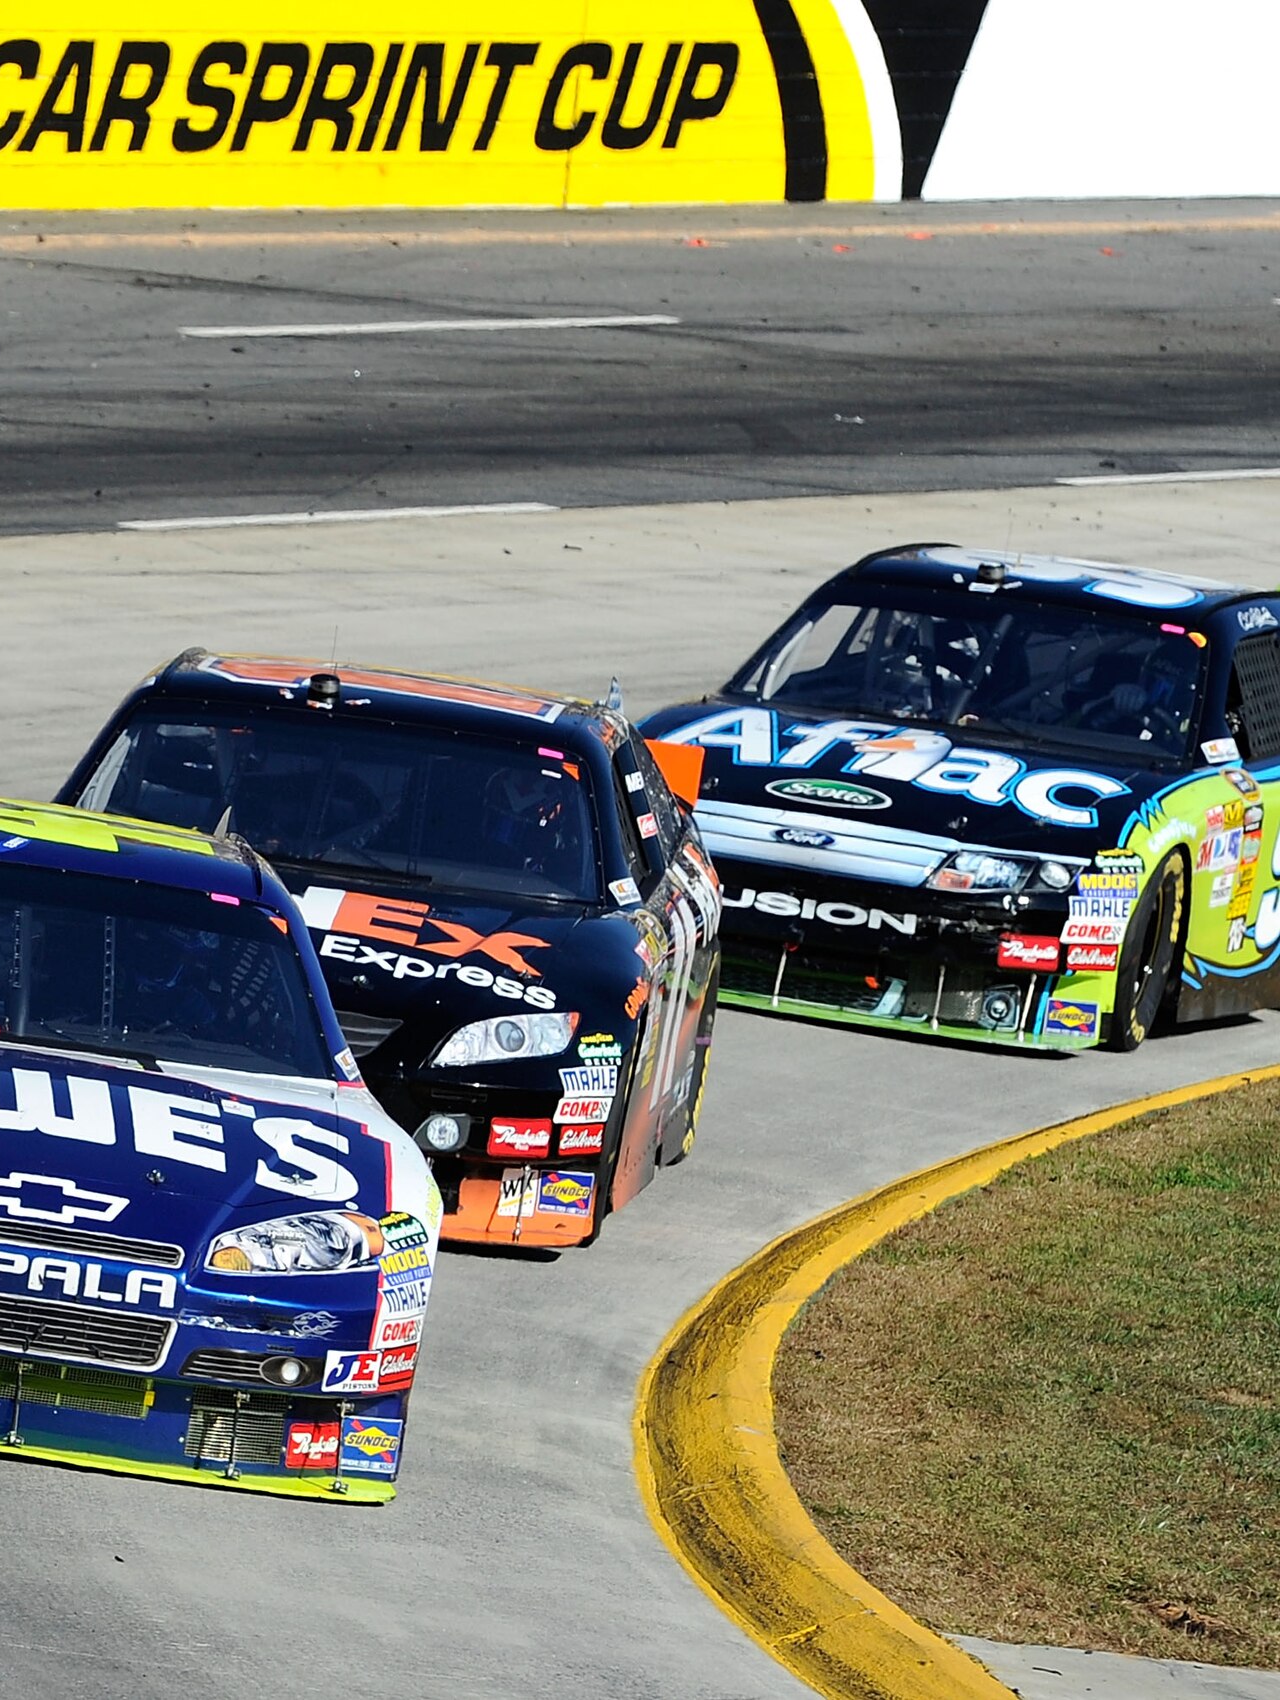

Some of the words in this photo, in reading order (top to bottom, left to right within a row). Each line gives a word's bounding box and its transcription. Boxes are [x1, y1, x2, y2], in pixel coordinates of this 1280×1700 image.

[172, 40, 540, 155] SPRINT
[539, 40, 741, 152] CUP
[658, 705, 1133, 828] Aflac
[1078, 873, 1137, 890] MOOG
[718, 883, 918, 937] USION
[1070, 898, 1130, 920] MAHLE
[1066, 924, 1113, 938] COMP
[319, 933, 558, 1011] Express
[1048, 1010, 1095, 1023] SUNOCO
[562, 1067, 616, 1092] MAHLE
[559, 1101, 600, 1117] COMP
[542, 1184, 593, 1198] SUNOCO
[390, 1233, 429, 1251] BELTS
[378, 1247, 429, 1276] MOOG
[382, 1281, 427, 1313] MAHLE
[382, 1319, 416, 1342] COMP
[325, 1353, 379, 1388] JE
[341, 1382, 378, 1390] PISTONS
[345, 1433, 400, 1449] SUNOCO
